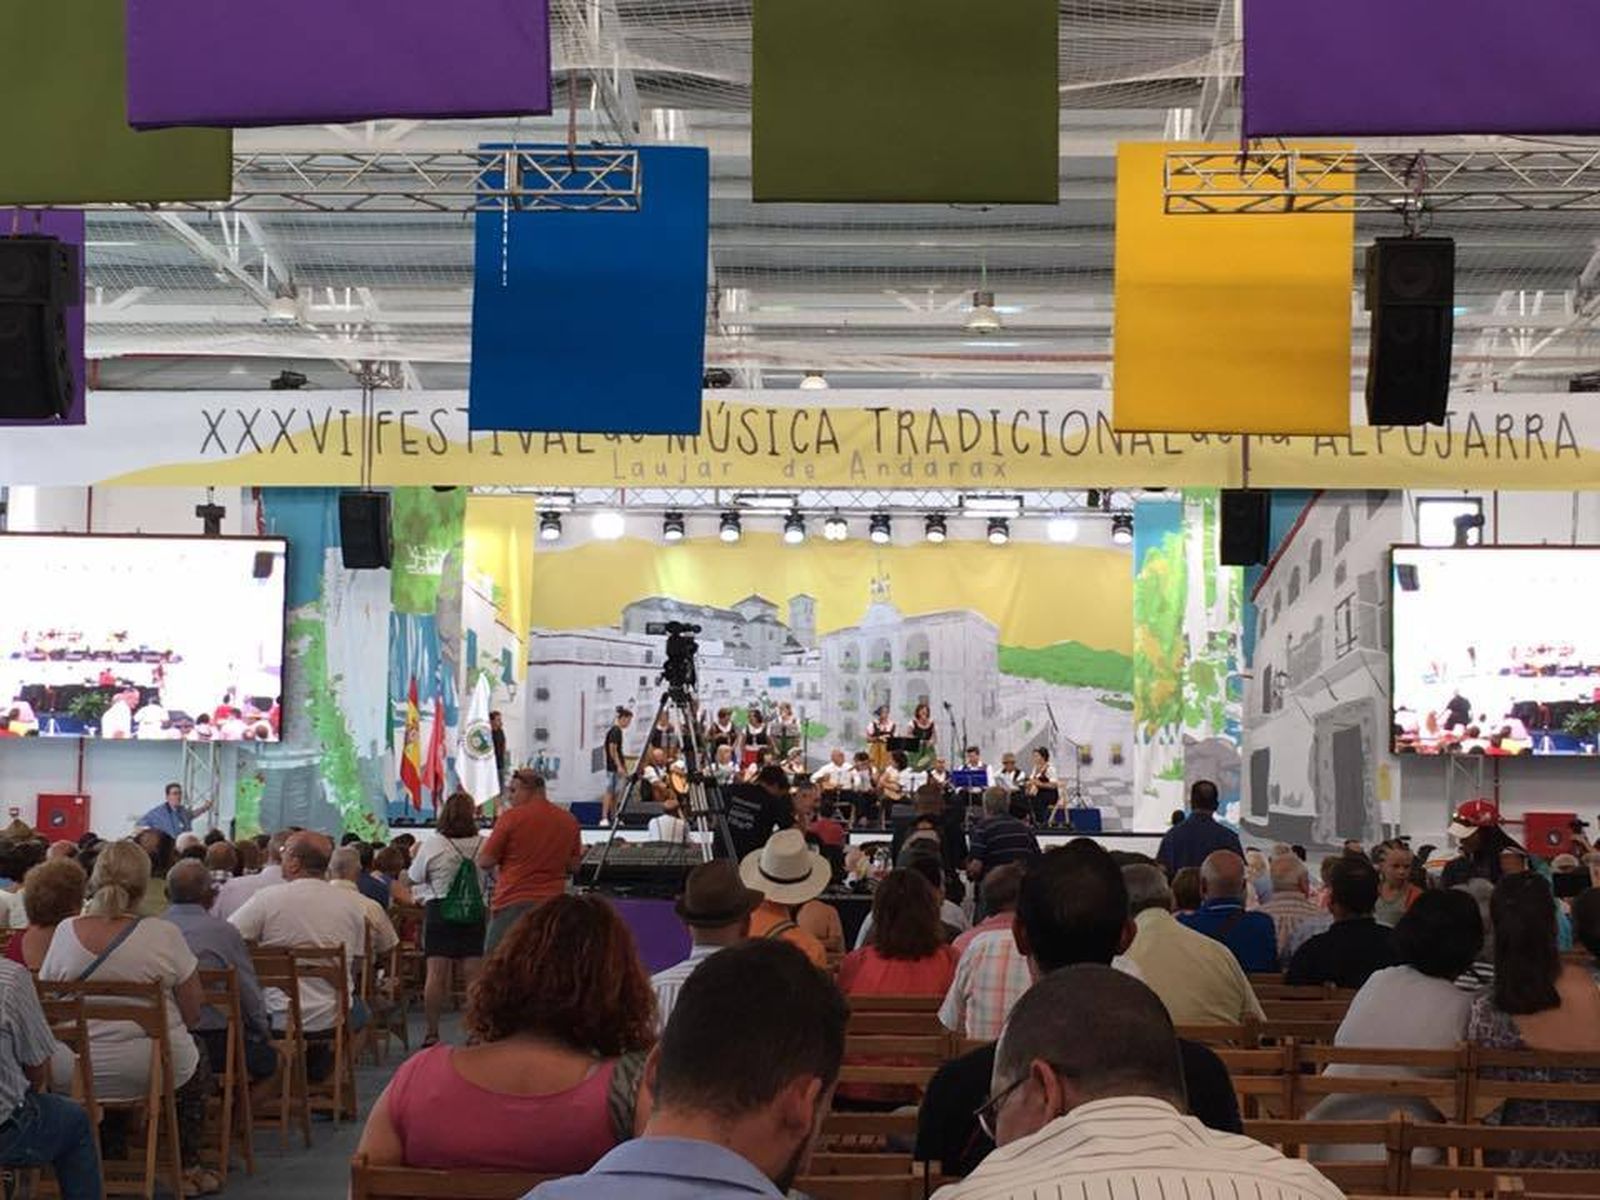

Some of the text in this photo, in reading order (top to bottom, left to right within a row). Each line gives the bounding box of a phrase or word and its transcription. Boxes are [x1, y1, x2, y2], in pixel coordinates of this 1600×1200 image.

[200, 406, 354, 455] XXXVI
[613, 449, 1010, 483] Laujar de Andarax
